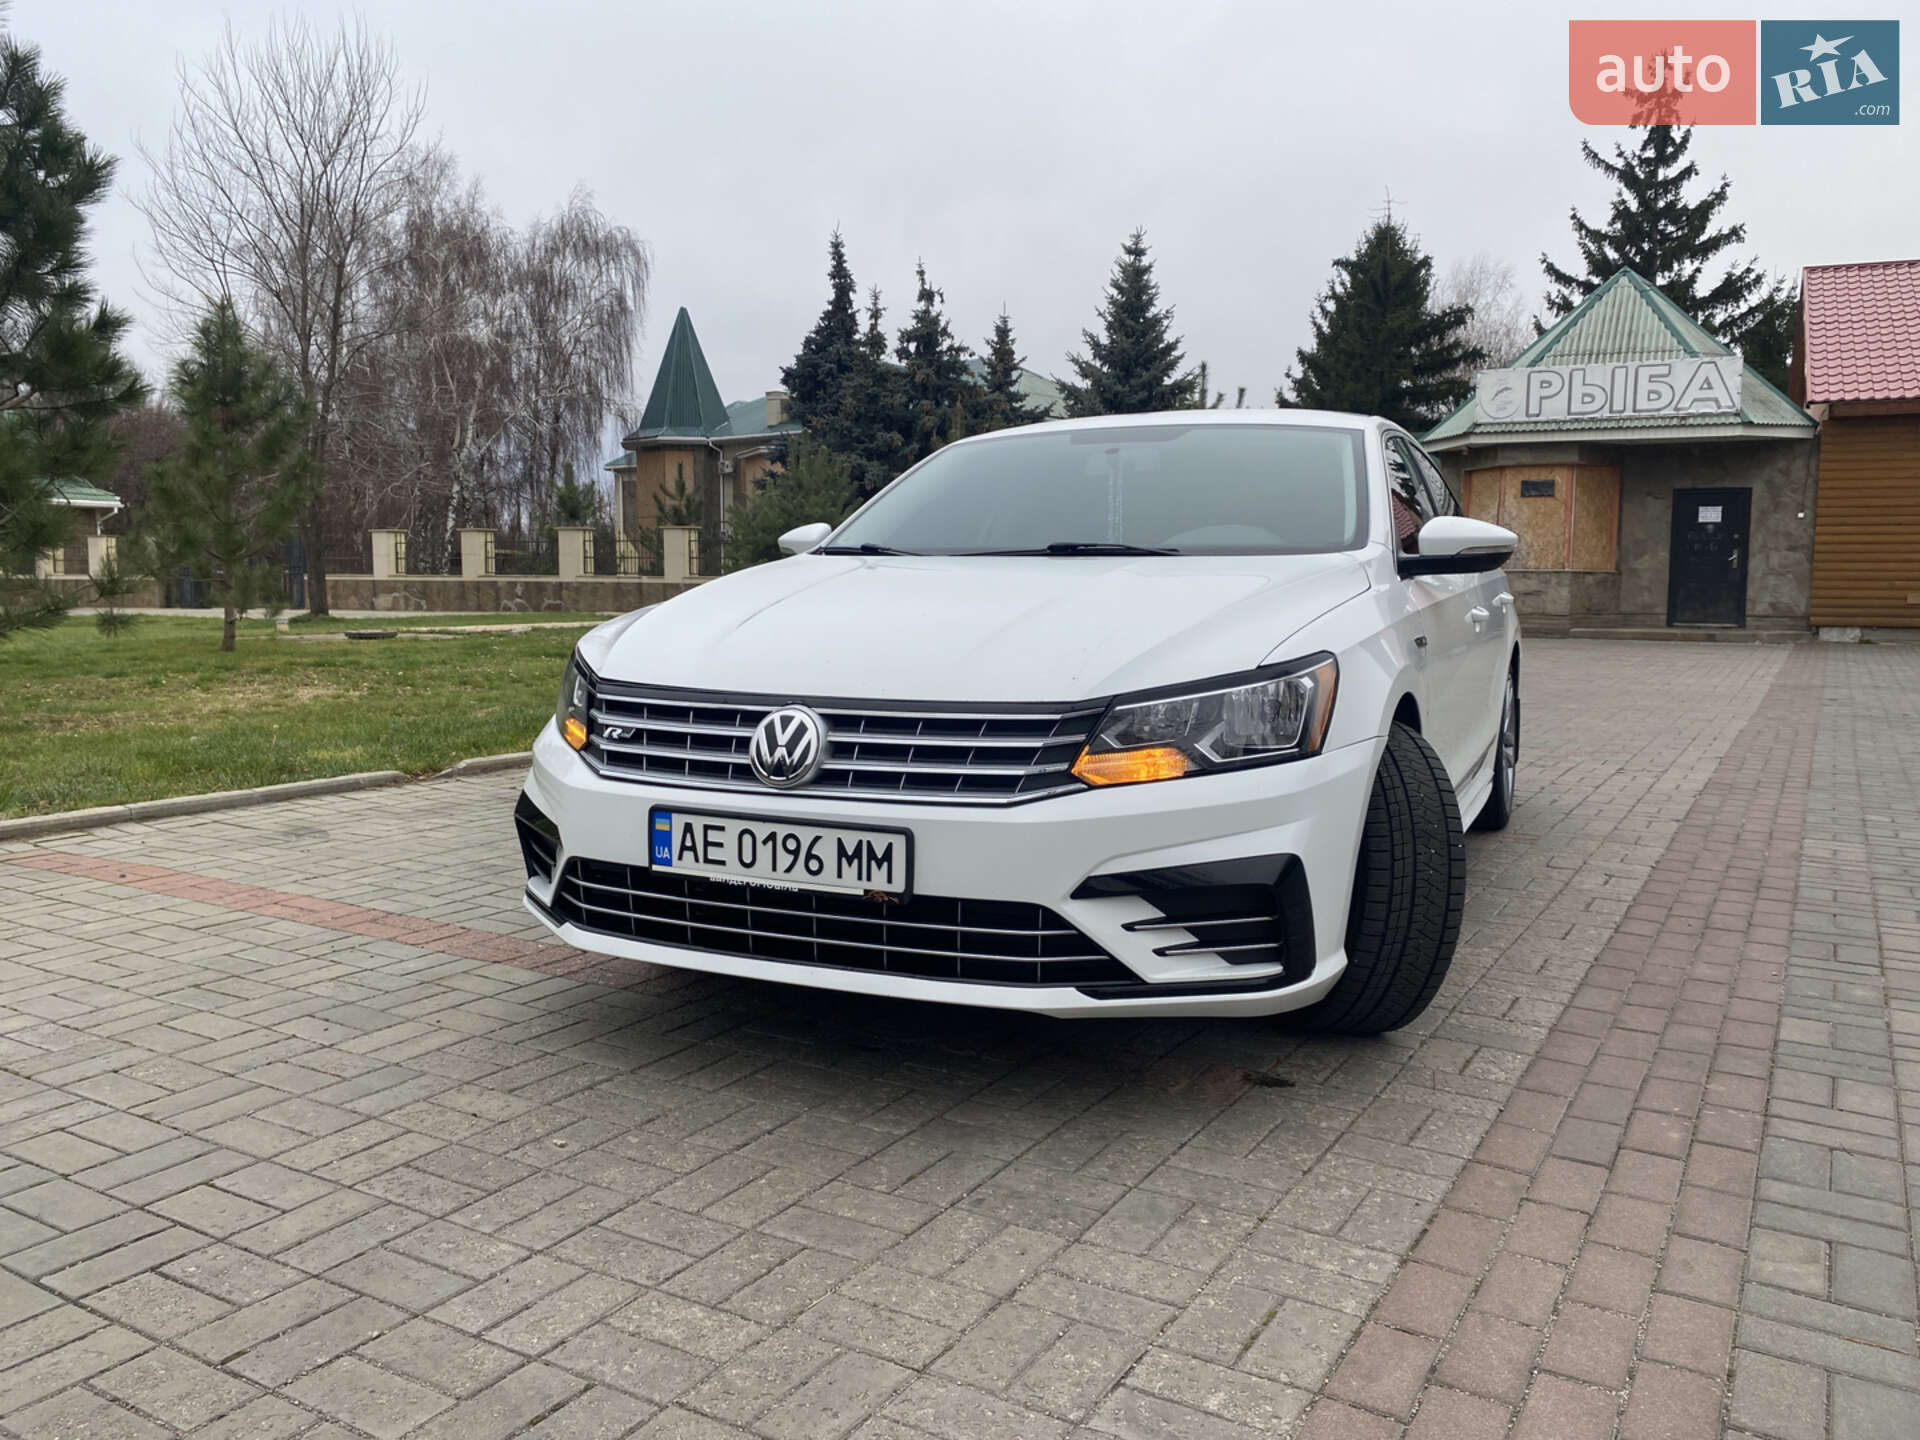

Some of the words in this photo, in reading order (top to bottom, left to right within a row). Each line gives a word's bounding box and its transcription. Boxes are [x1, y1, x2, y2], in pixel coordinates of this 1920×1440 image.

[1525, 361, 1736, 418] РЫБА
[655, 847, 670, 860] UA
[678, 822, 727, 866] AE
[738, 828, 825, 877] 0196
[837, 836, 893, 884] MM
